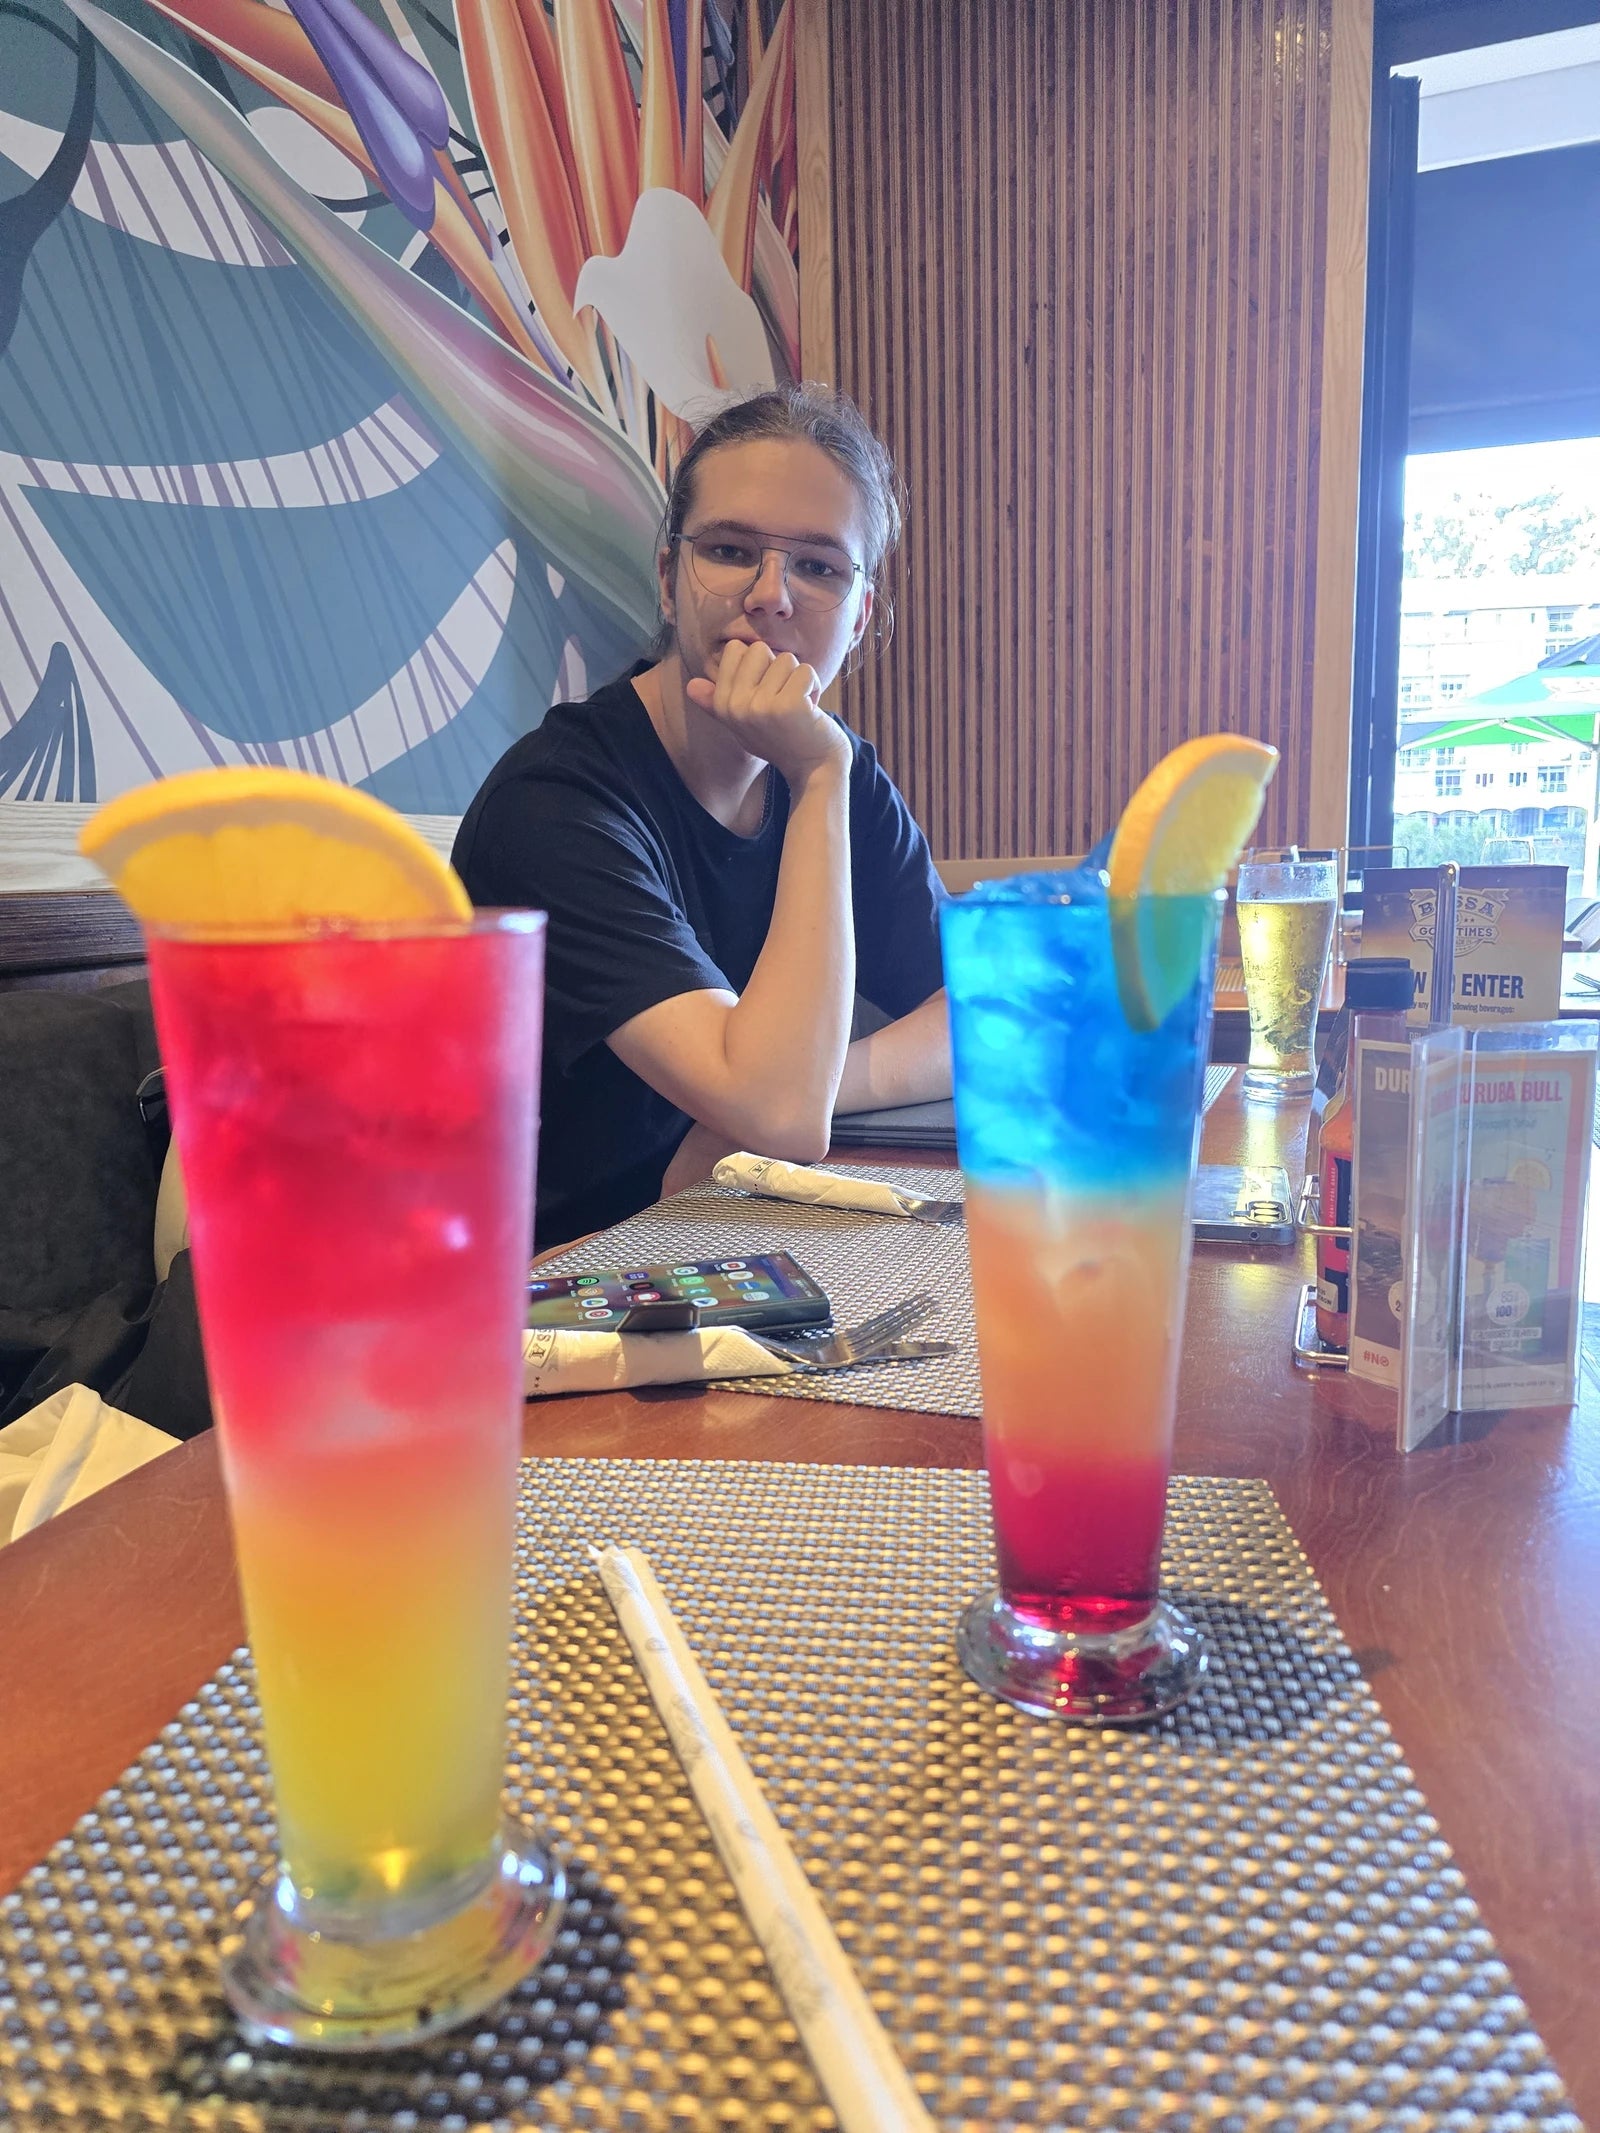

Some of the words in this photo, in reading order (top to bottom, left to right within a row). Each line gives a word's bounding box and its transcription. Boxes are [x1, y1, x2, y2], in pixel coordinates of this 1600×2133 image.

[1418, 895, 1495, 918] BSSA
[1457, 927, 1493, 937] TIMES
[1461, 973, 1524, 999] ENTER
[1452, 1001, 1478, 1013] ollowing
[1521, 1080, 1563, 1102] BULL
[1495, 1305, 1513, 1318] 100
